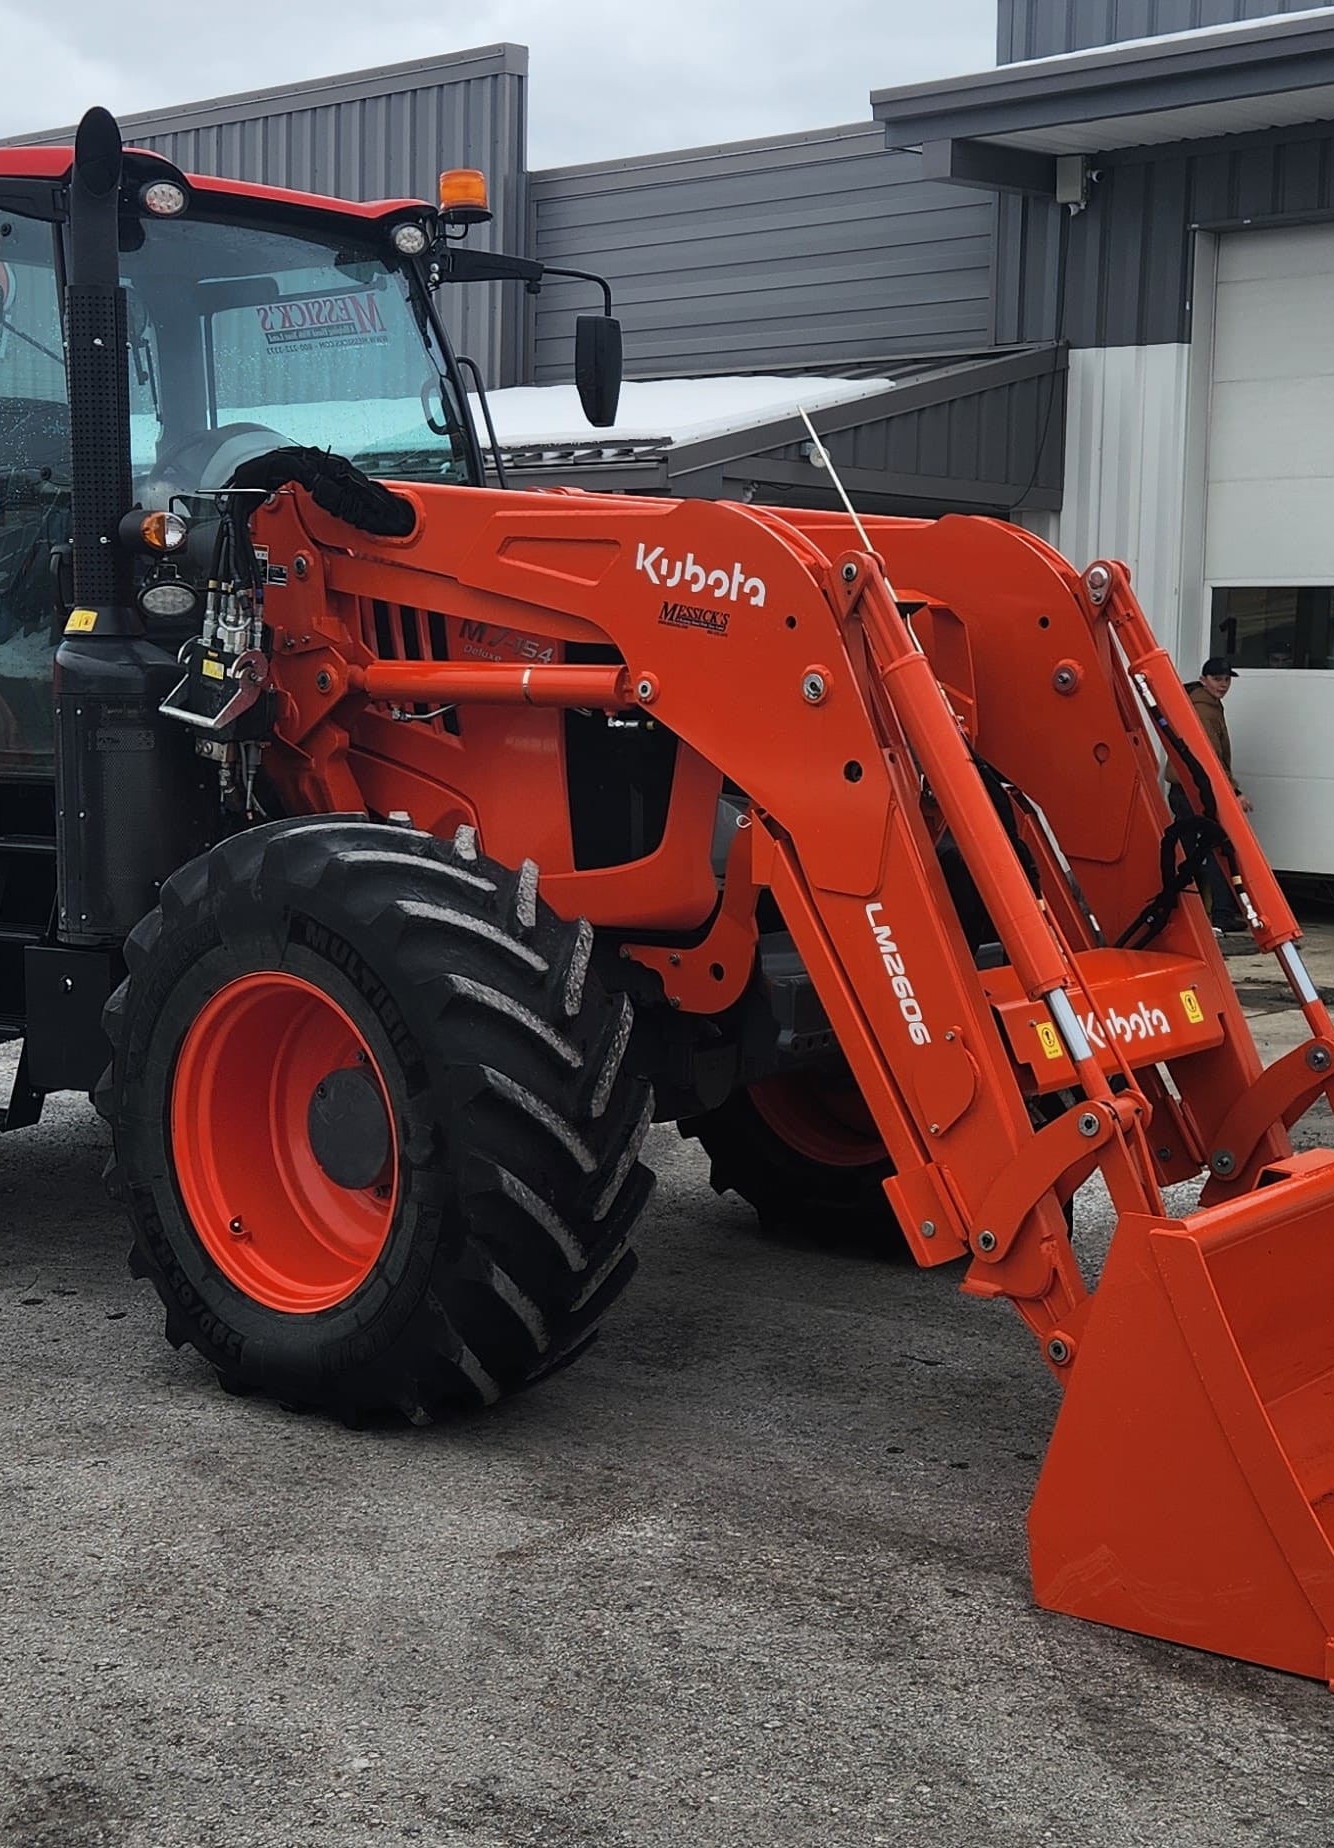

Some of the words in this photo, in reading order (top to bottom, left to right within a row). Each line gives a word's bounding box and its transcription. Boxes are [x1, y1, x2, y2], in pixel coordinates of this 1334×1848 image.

[636, 543, 766, 607] Kubota
[658, 601, 730, 626] MESSICK'S
[464, 643, 502, 662] Deluxe
[866, 902, 932, 1046] LM2606
